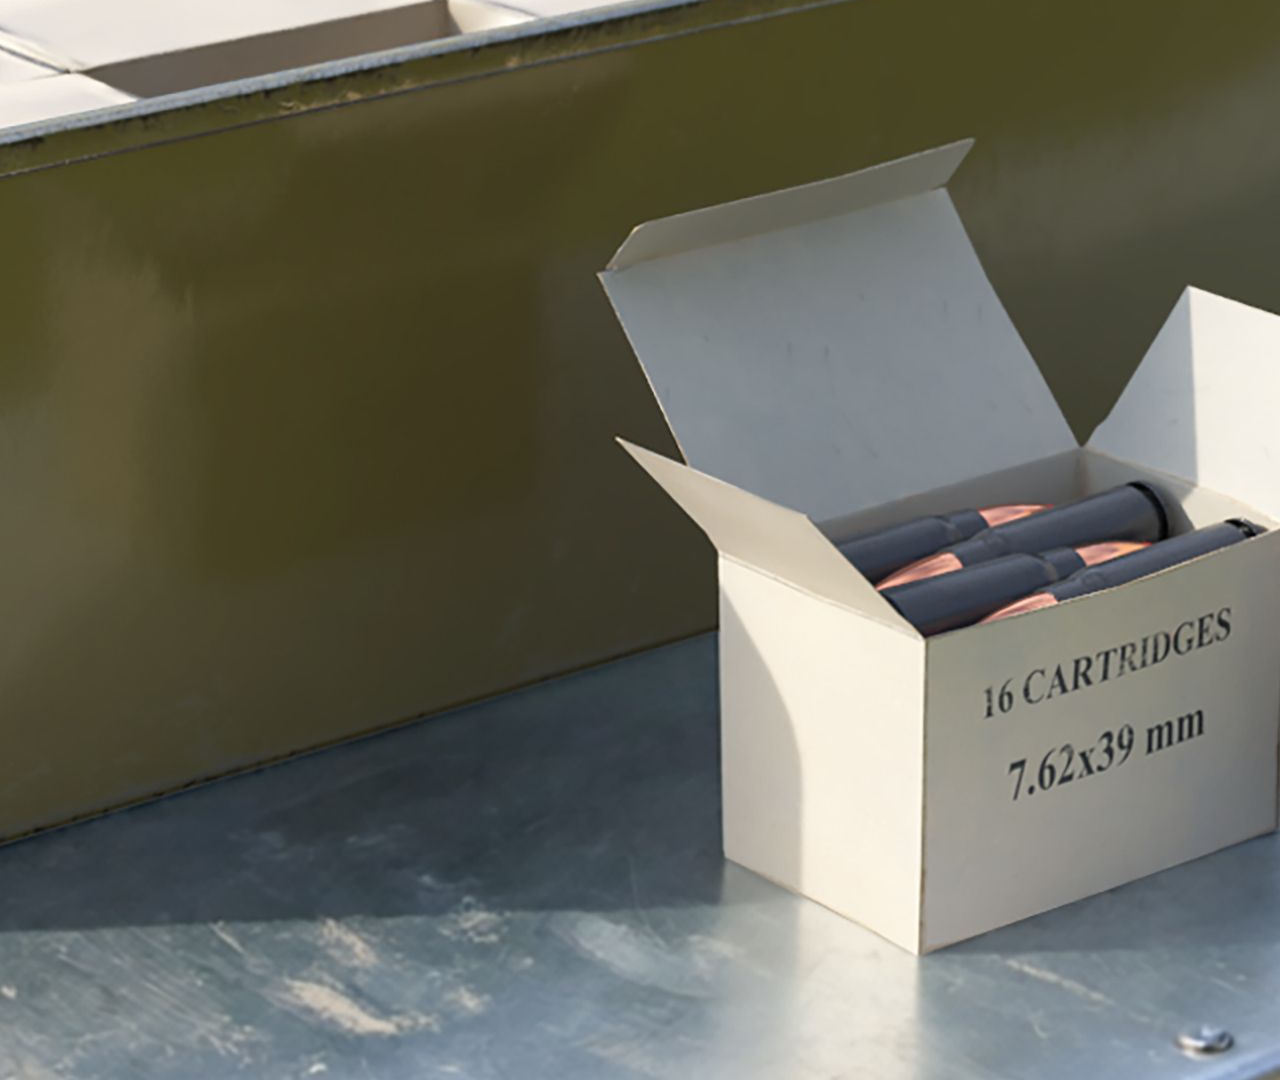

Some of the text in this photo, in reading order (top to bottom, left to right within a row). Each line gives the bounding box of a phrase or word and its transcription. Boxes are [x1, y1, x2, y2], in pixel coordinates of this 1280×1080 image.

[983, 606, 1233, 720] 16 CARTRIDGES
[1007, 708, 1205, 802] 7.62x39 mm
